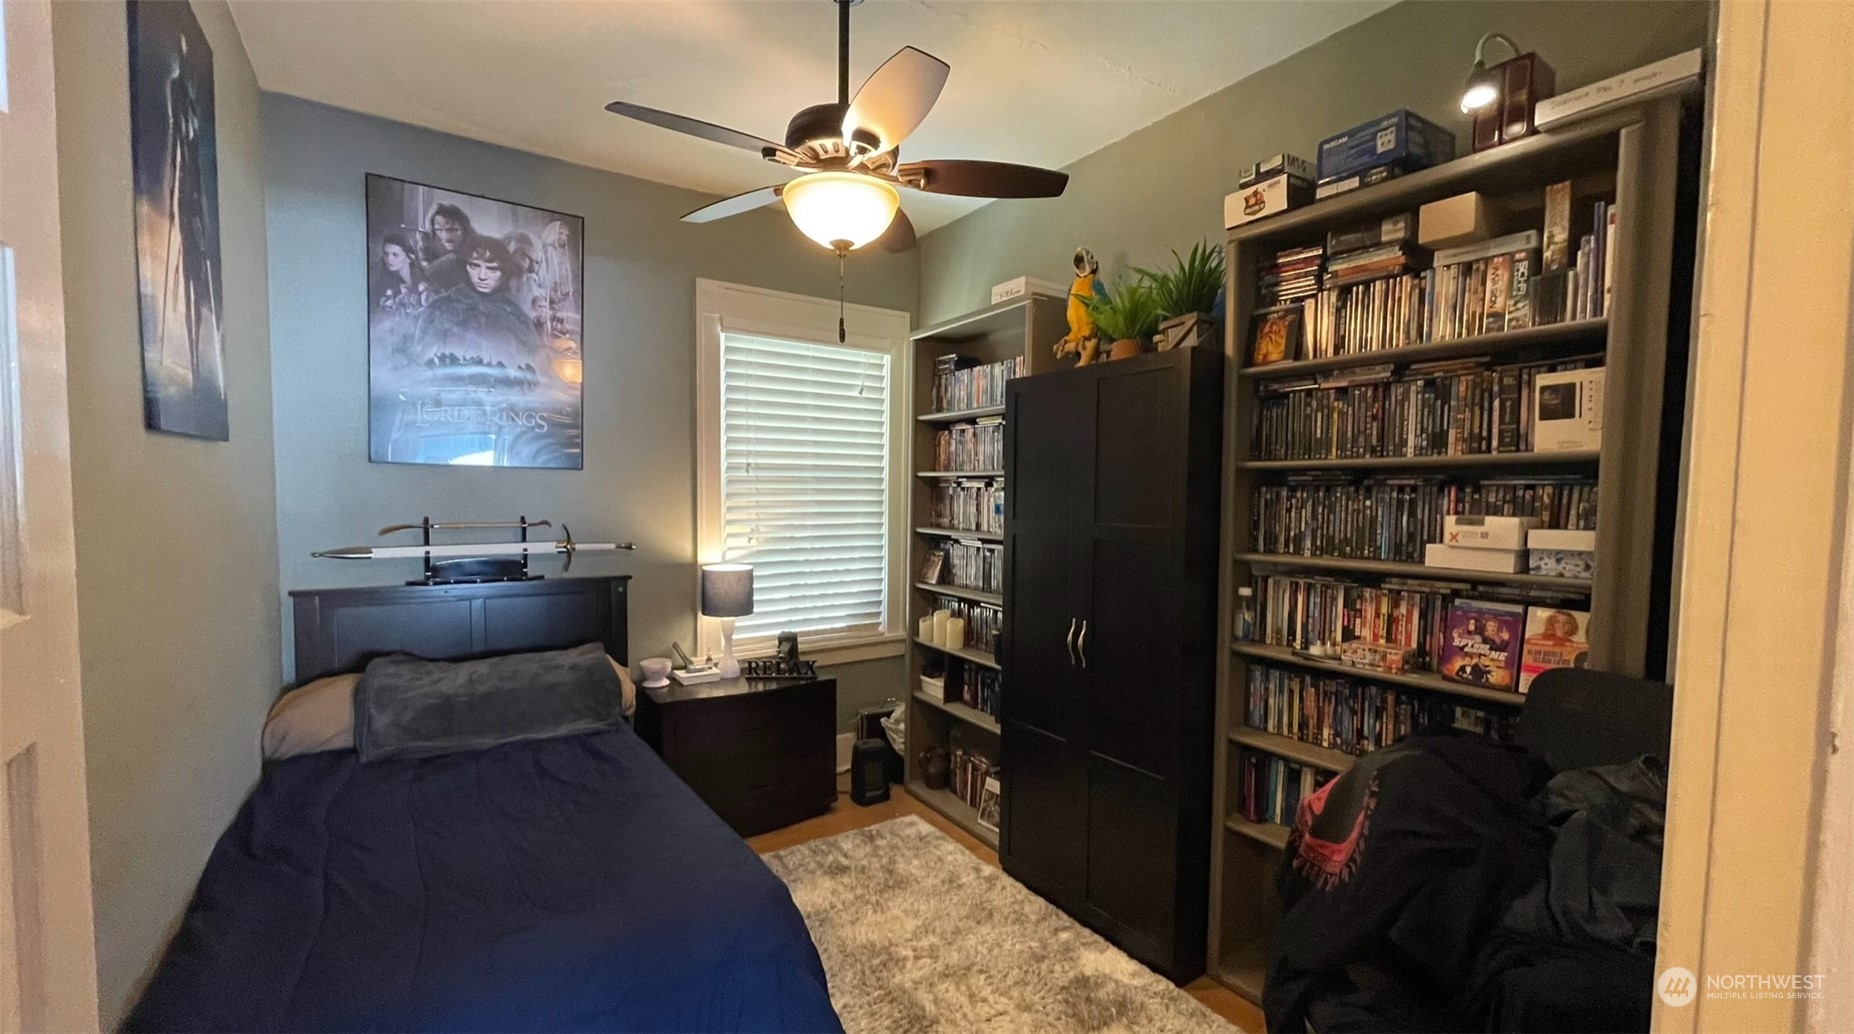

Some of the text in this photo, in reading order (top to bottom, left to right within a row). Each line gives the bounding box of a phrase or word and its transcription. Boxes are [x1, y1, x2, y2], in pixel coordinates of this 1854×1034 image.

[485, 401, 548, 433] RINGS
[1452, 637, 1476, 649] SPY
[746, 660, 818, 677] RELAX
